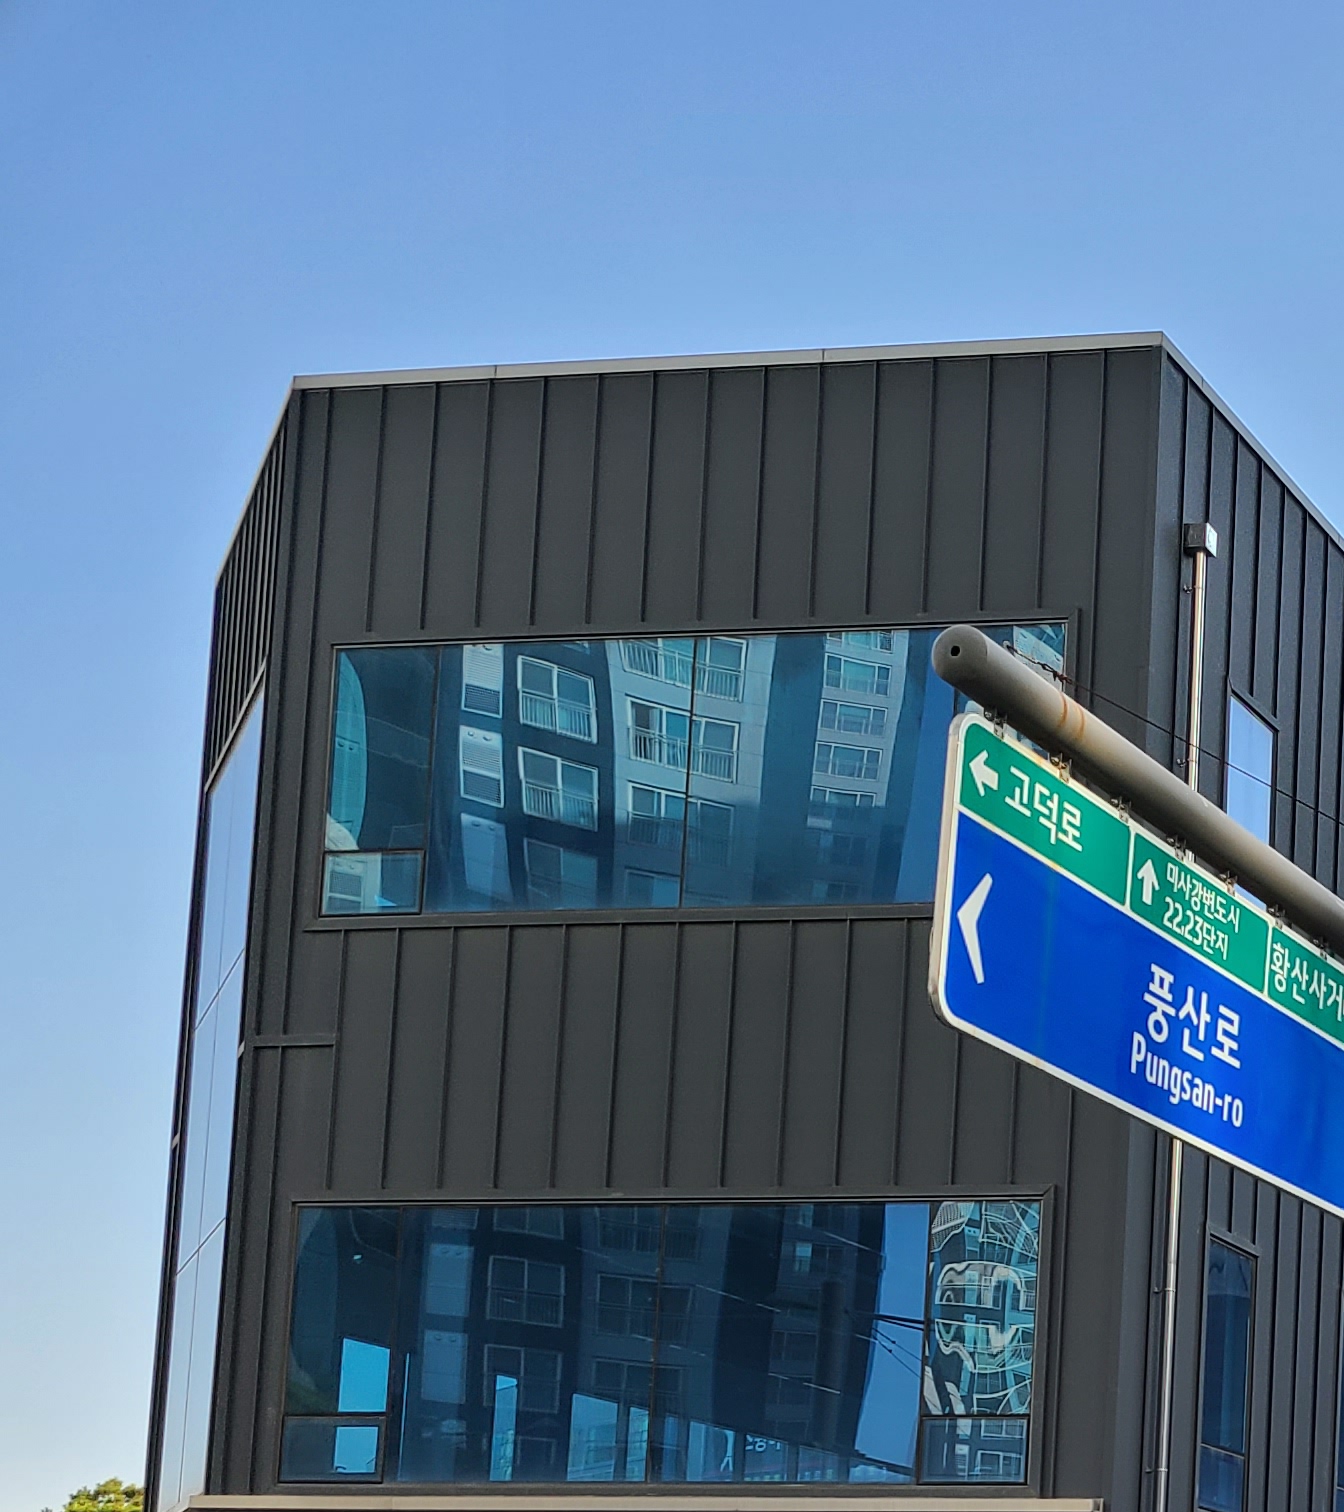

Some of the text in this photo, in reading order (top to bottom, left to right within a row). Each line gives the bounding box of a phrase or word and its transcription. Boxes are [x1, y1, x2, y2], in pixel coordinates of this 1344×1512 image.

[1005, 766, 1083, 852] 고덕로
[1166, 862, 1240, 933] 미사강변도시
[1143, 963, 1241, 1069] 풍산로
[1131, 1031, 1243, 1128] Pungsan-ro
